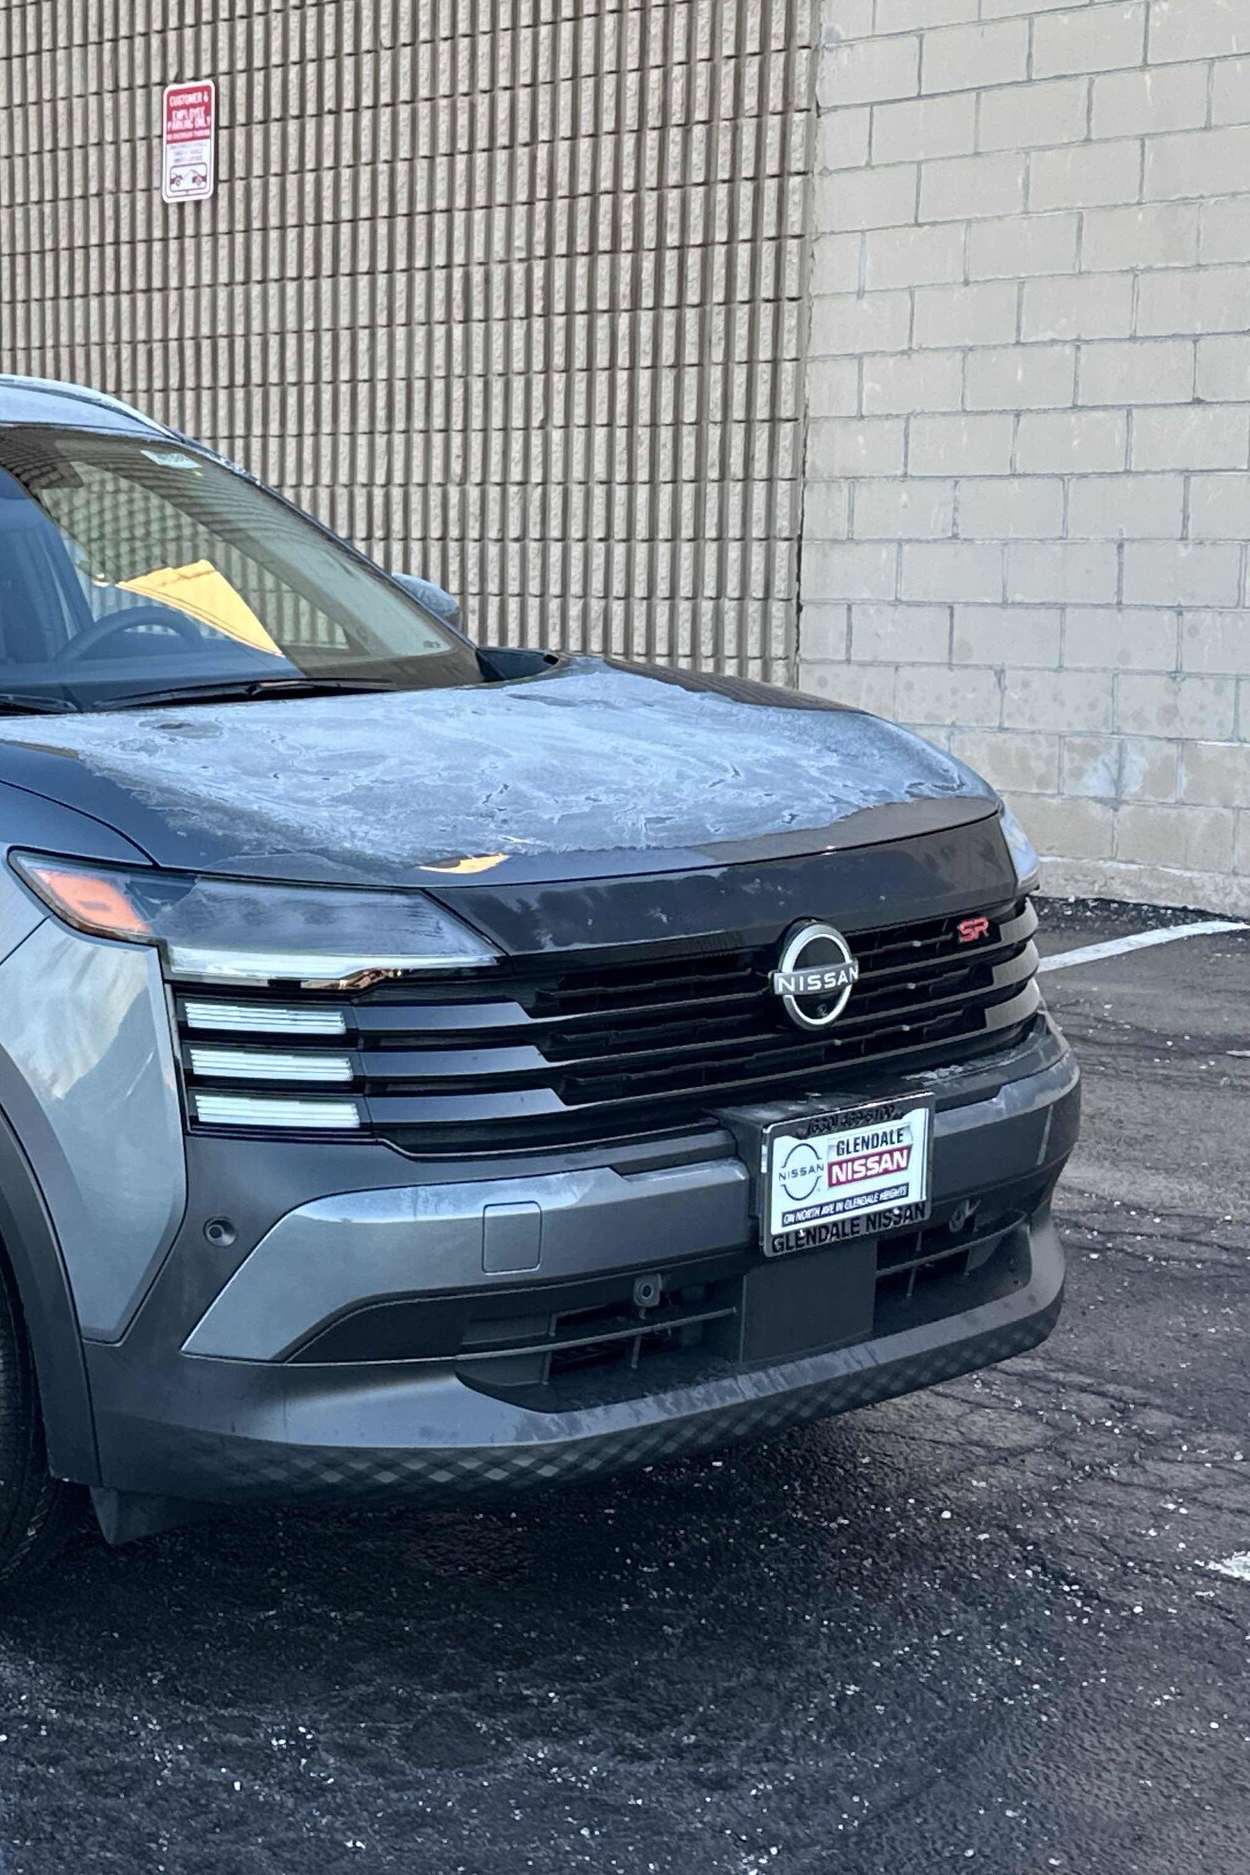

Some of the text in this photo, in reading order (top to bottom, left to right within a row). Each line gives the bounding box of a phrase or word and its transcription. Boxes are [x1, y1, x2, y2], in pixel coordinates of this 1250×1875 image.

[957, 917, 989, 943] SR
[778, 967, 859, 992] NISSAN
[836, 1127, 904, 1157] GLENDALE
[778, 1163, 825, 1182] NISSAN
[831, 1149, 908, 1184] NISSAN
[783, 1213, 795, 1225] ON
[796, 1207, 820, 1221] NORTH
[821, 1203, 835, 1216] AVE
[835, 1201, 844, 1212] IN
[844, 1192, 879, 1211] GLENDALE
[771, 1202, 926, 1254] GLENDALE NISSAN
